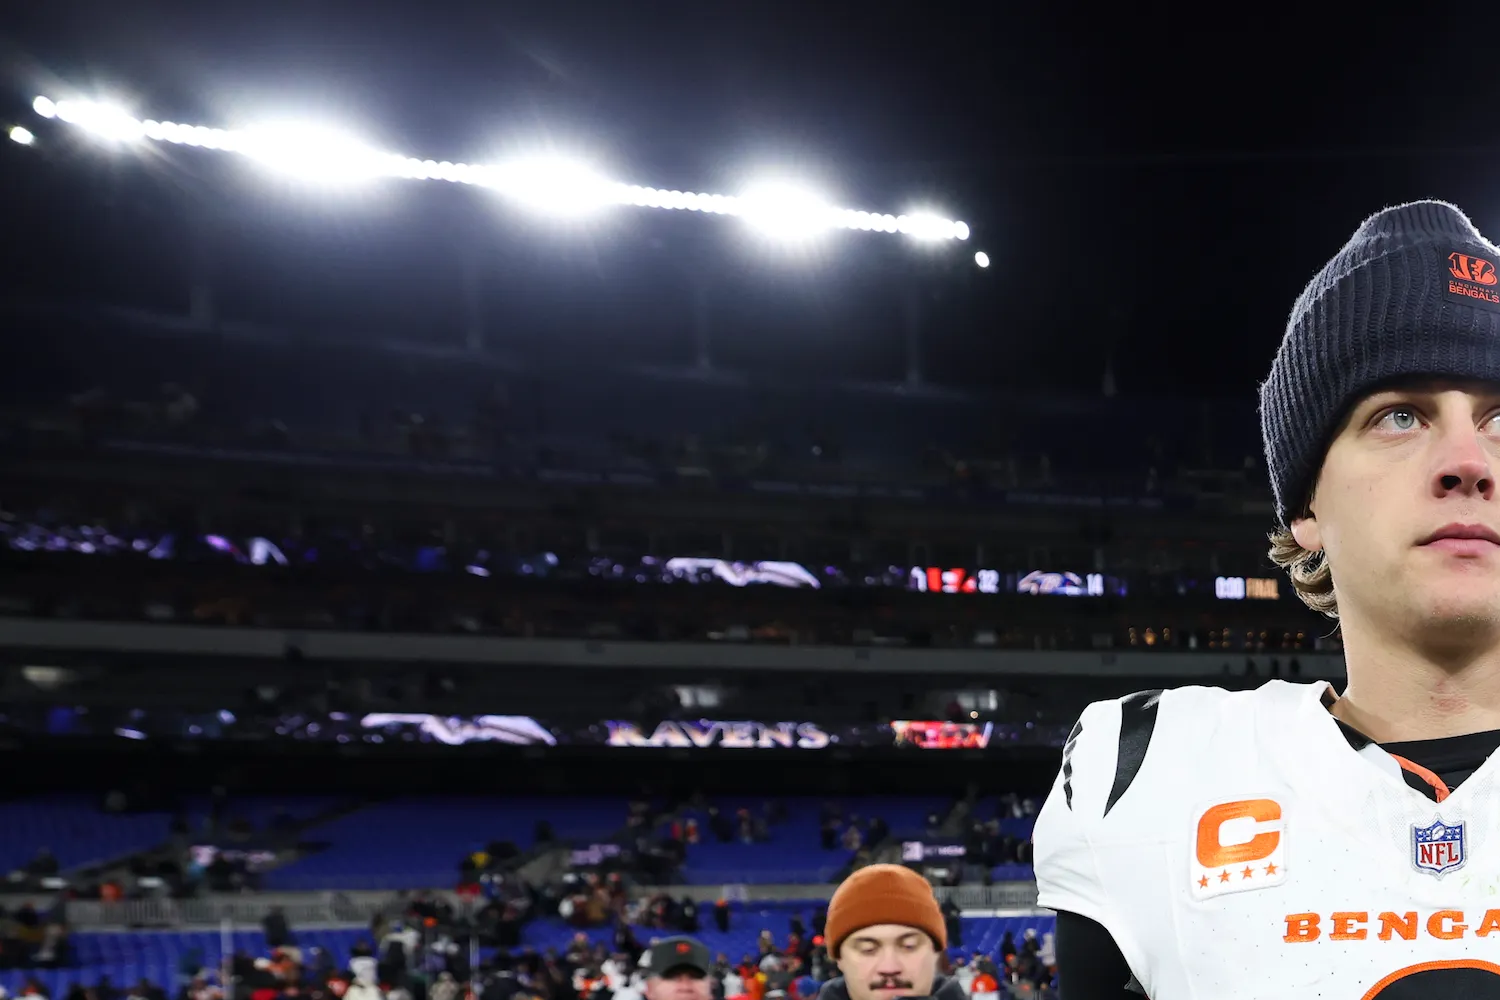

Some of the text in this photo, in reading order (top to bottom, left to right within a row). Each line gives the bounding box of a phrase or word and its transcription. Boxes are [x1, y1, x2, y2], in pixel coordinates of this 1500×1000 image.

[1449, 284, 1500, 303] BENGALS
[977, 569, 998, 593] 32
[1087, 573, 1103, 596] 14
[605, 721, 830, 748] RAVENS
[1196, 798, 1281, 868] C
[1420, 843, 1459, 867] NFL
